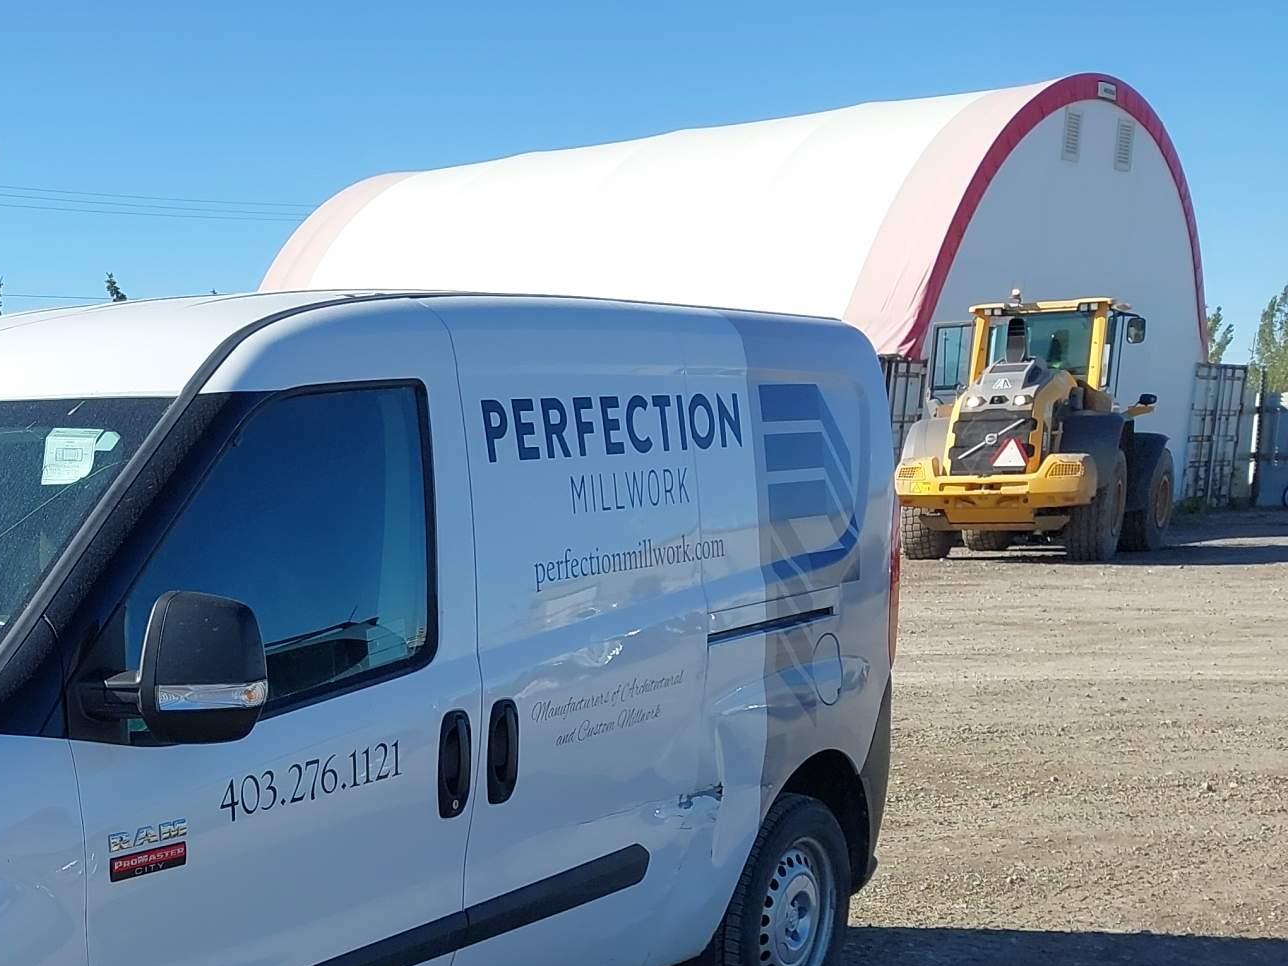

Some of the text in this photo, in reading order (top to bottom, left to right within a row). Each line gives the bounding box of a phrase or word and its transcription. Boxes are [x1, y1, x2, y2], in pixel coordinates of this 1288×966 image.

[480, 392, 744, 464] PERFECTION
[569, 467, 691, 514] MILLWORK
[534, 535, 726, 591] perfectionmillwork.com
[531, 692, 610, 724] Manufacturers
[556, 726, 576, 746] and
[616, 704, 661, 729] Millwork
[219, 739, 404, 822] 403.276.1121
[108, 818, 187, 853] RAM
[134, 862, 164, 875] CITY
